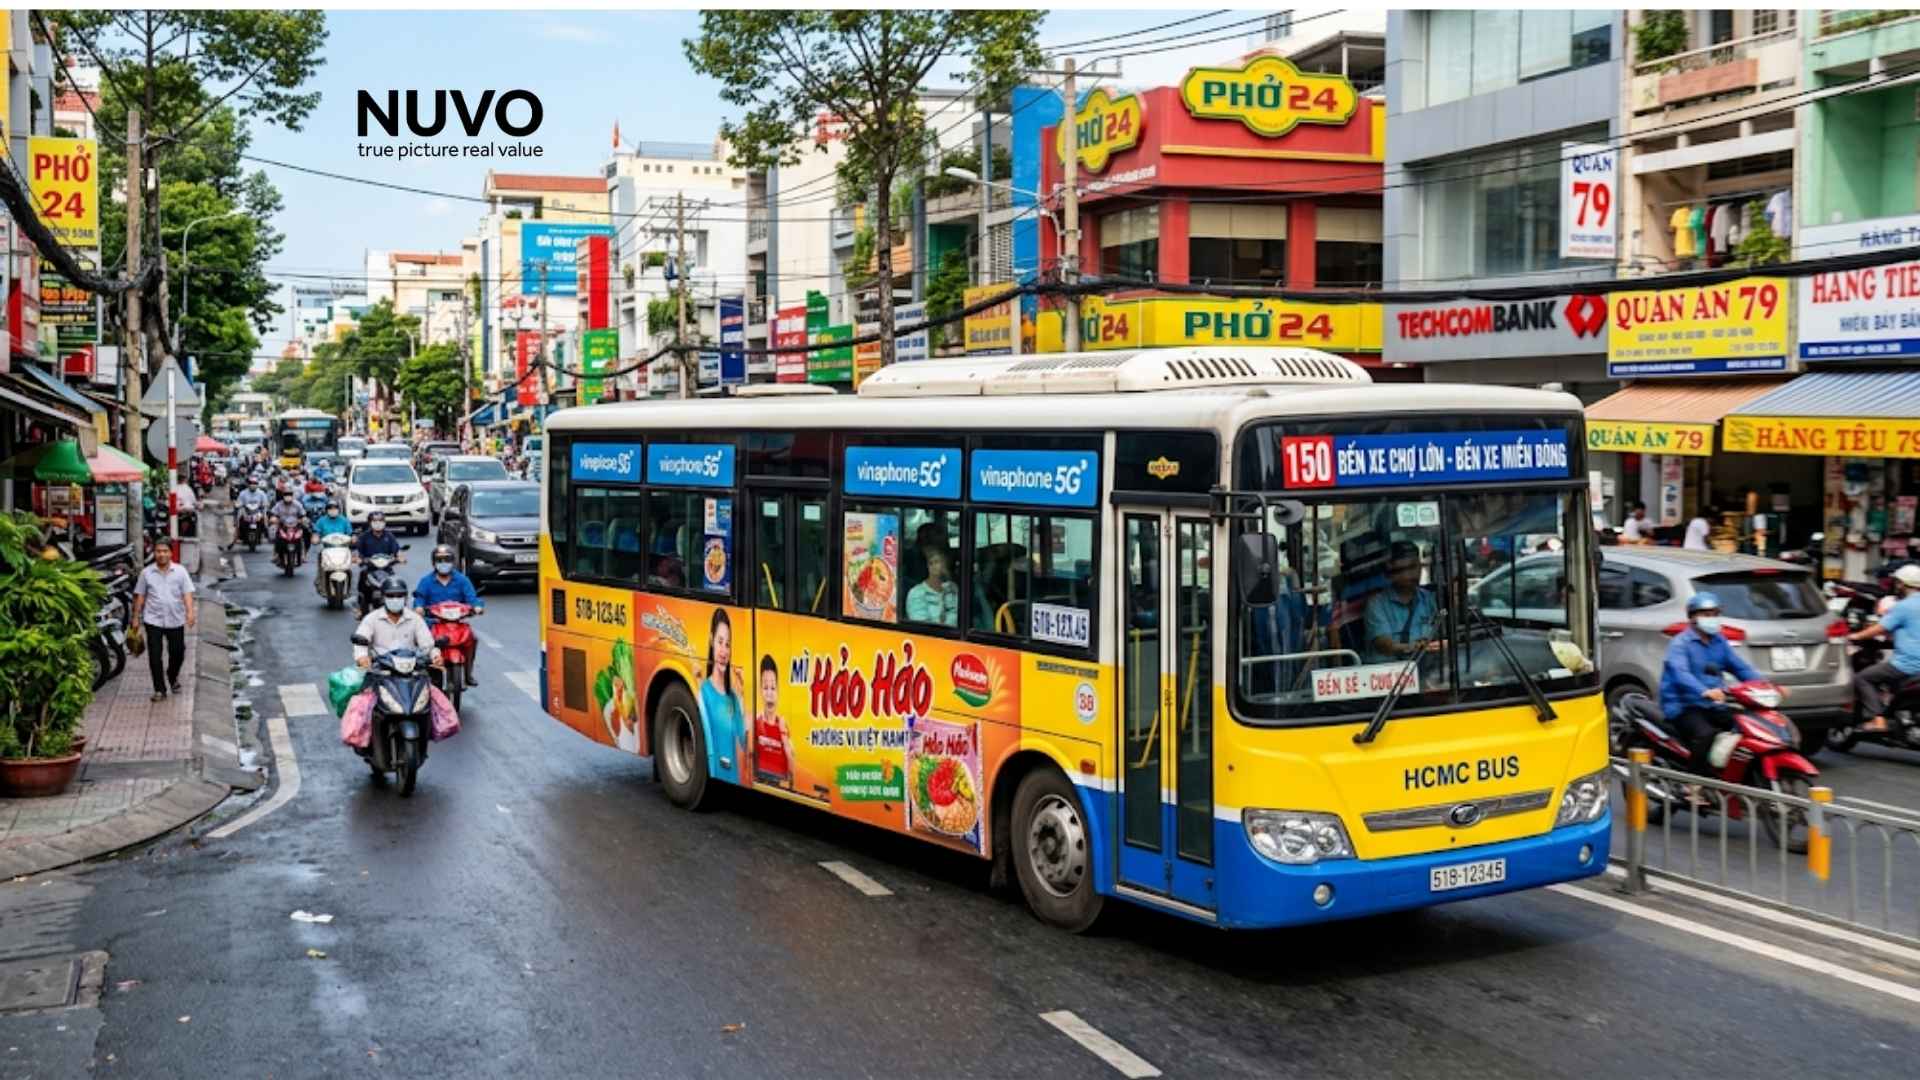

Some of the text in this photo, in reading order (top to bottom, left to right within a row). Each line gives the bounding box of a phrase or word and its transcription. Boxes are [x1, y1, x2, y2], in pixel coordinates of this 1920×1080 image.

[1203, 74, 1338, 112] PHỞ 24
[1105, 108, 1132, 141] 24
[34, 144, 91, 182] PHỞ
[42, 191, 85, 219] 24
[1573, 182, 1610, 227] 79
[1185, 302, 1333, 340] PHỞ 24
[1397, 300, 1557, 340] TECHCOMBANK
[1739, 284, 1778, 321] 79
[1102, 313, 1129, 342] 24
[1588, 425, 1637, 447] QUÁN
[1675, 430, 1704, 449] 79
[1756, 422, 1826, 450] HÀNG
[857, 460, 919, 486] vinaphone
[1286, 440, 1331, 482] 150
[1338, 440, 1365, 475] BẾN
[1368, 448, 1386, 474] XE
[1389, 444, 1416, 478] CHỢ
[1455, 438, 1480, 471] BẾN
[1483, 445, 1500, 470] XE
[981, 465, 1052, 491] vinaphone
[811, 642, 932, 719] Hảo Hảo
[1405, 755, 1519, 790] HCMC BUS
